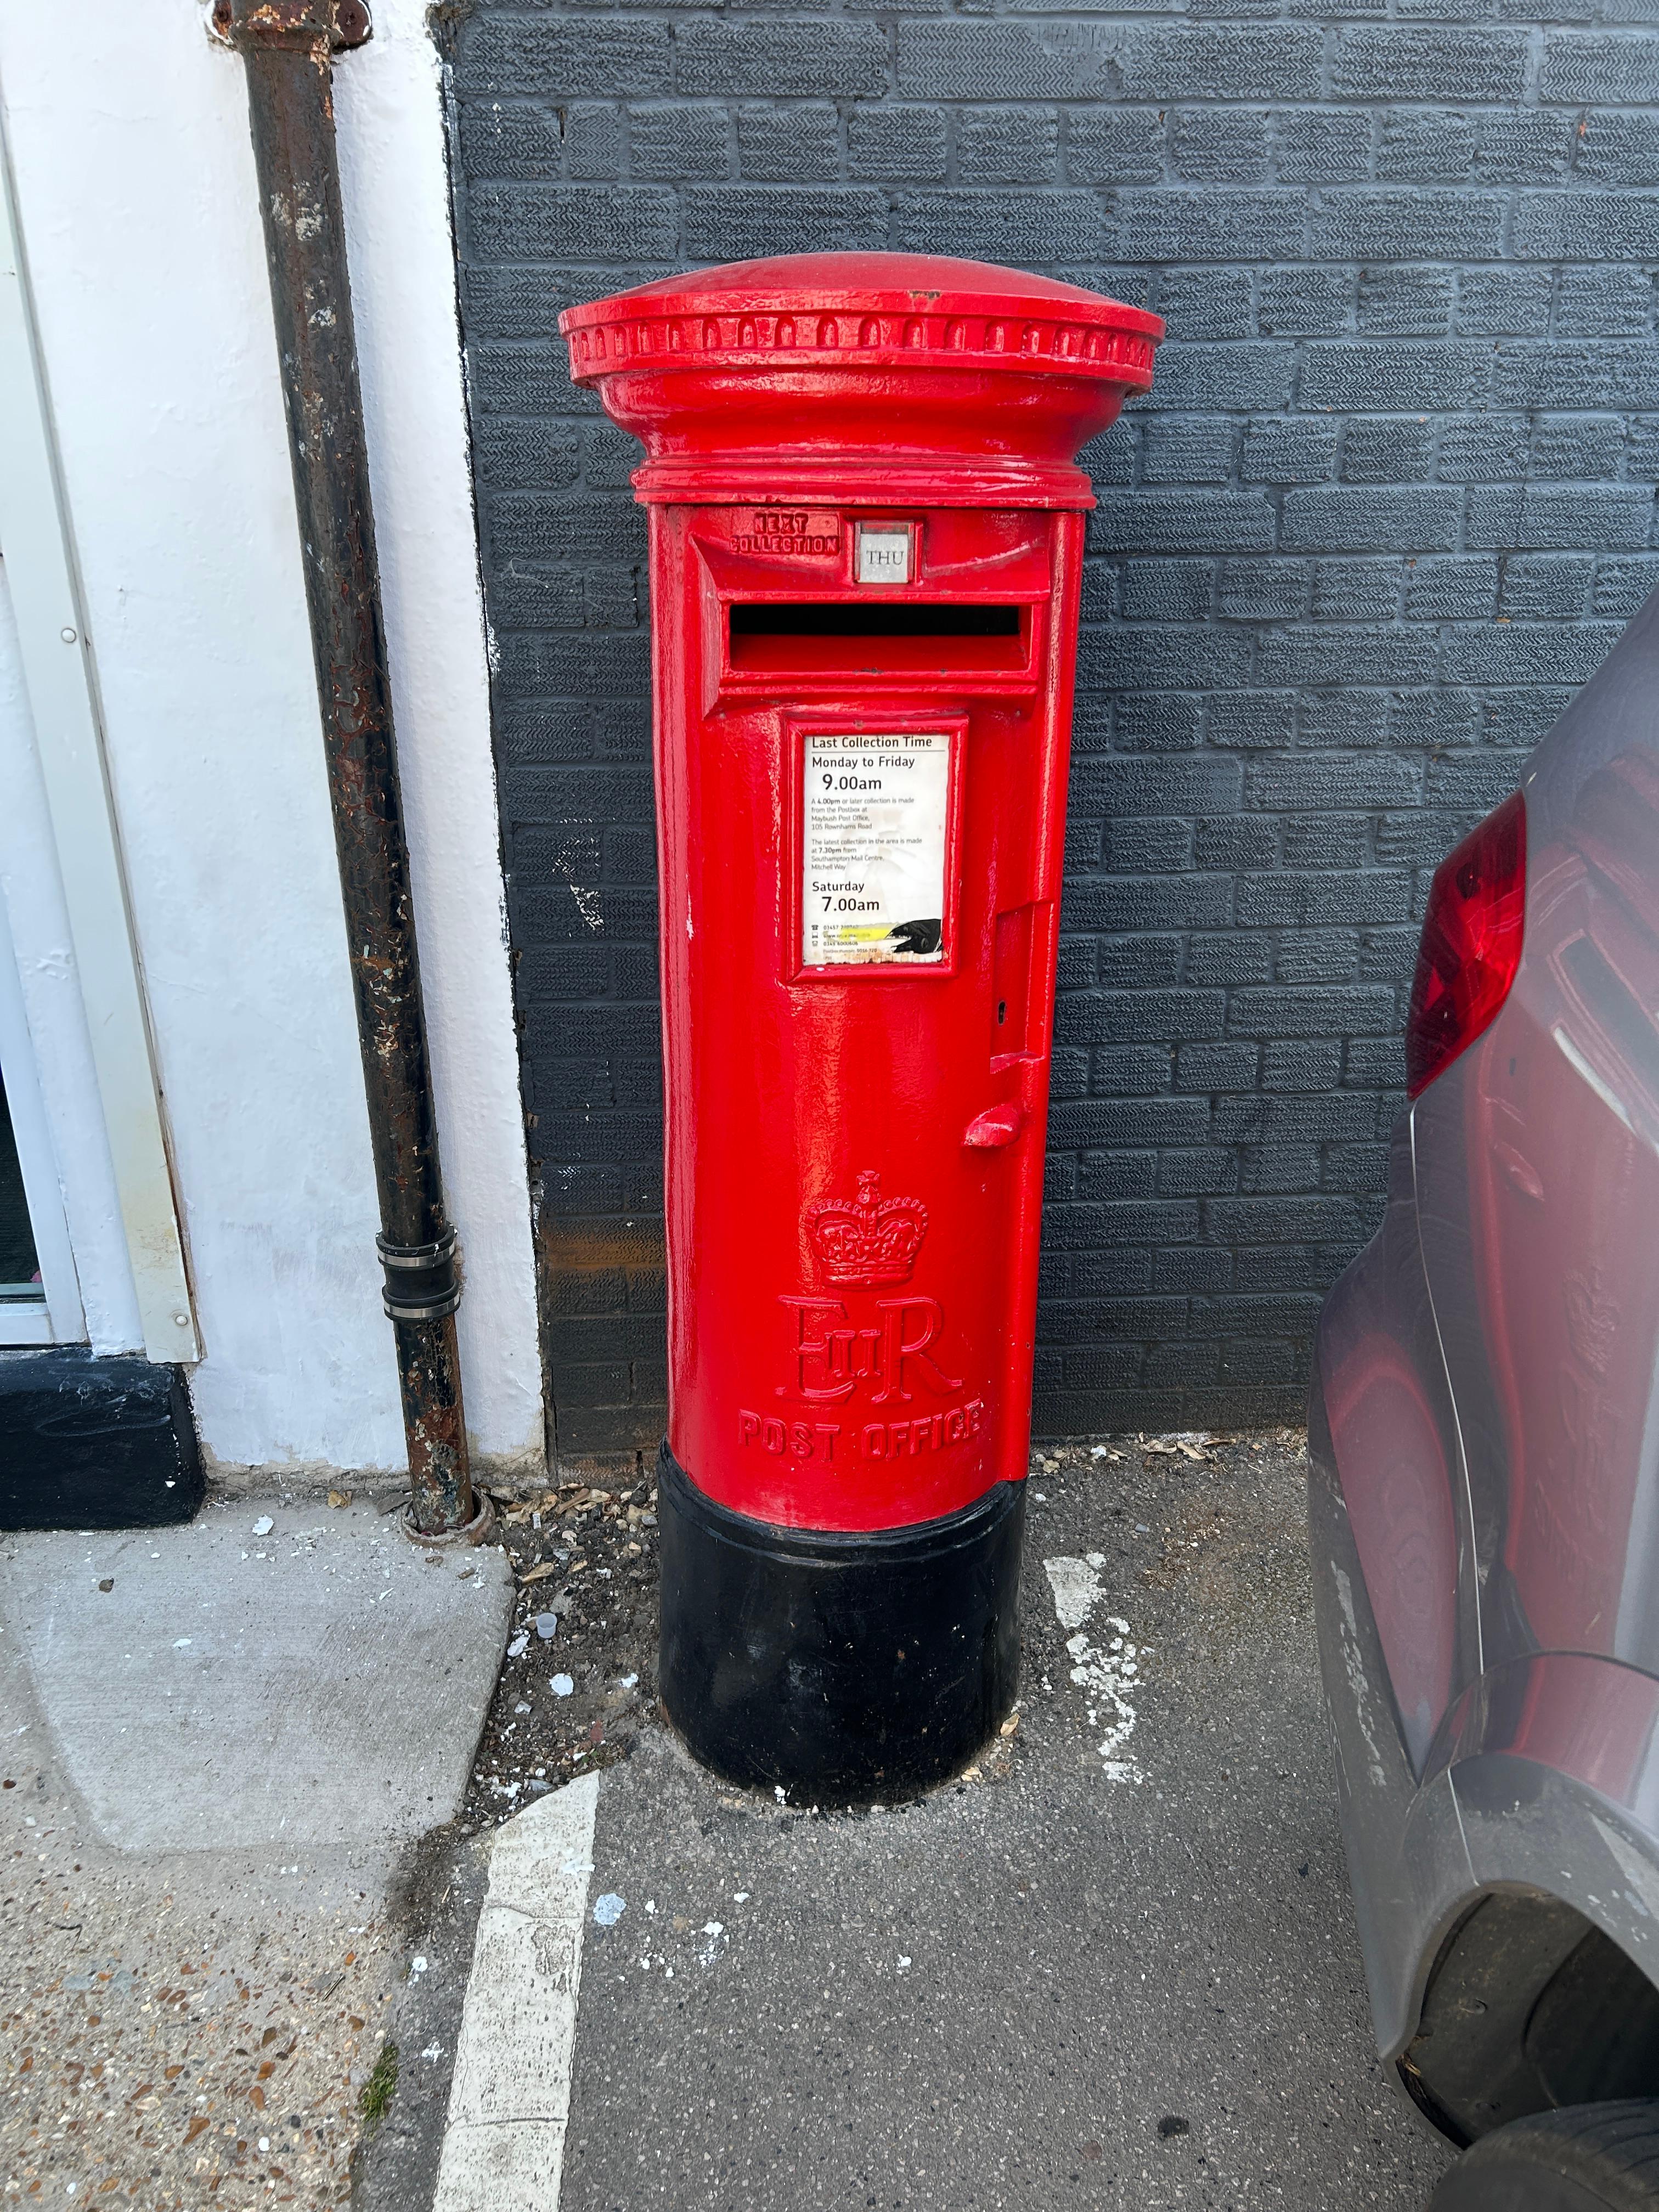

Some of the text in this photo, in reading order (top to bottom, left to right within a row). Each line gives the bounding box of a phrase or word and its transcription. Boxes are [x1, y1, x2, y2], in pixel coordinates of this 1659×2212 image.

[754, 512, 809, 534] NEXT
[729, 535, 840, 556] COLLECTION
[866, 550, 905, 566] THU
[812, 735, 932, 748] Last Collection Time
[812, 756, 915, 769] Monday to Friday
[822, 774, 882, 791] 9.00am
[812, 882, 865, 893] Saturday
[822, 896, 879, 912] 7.00am
[738, 1398, 984, 1462] POST OFFICE
